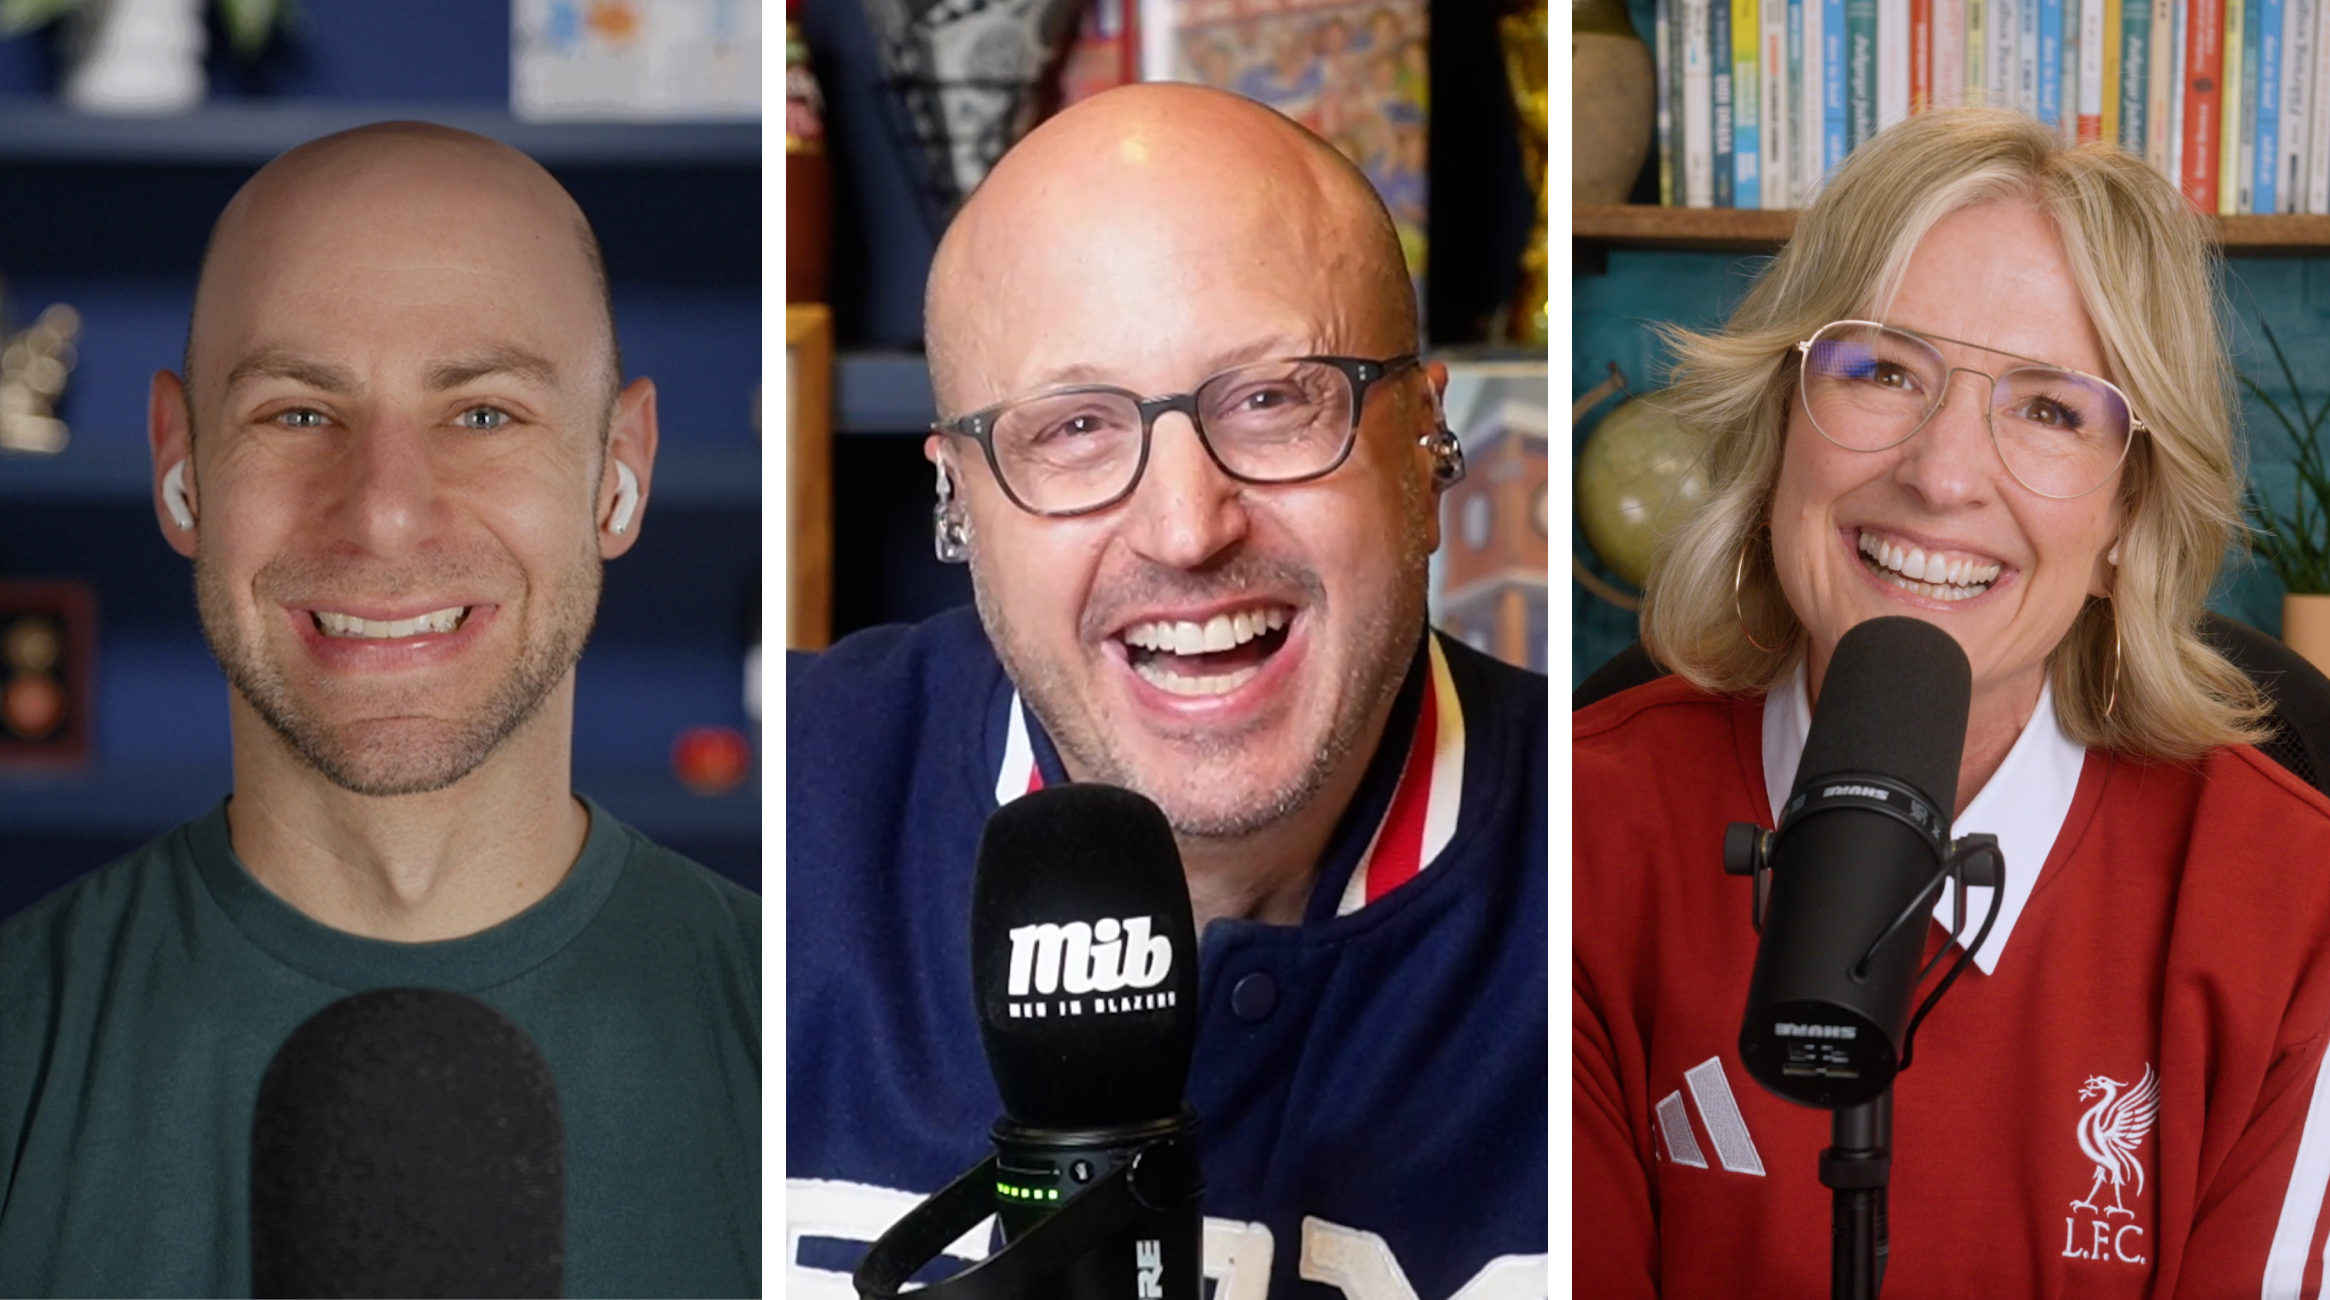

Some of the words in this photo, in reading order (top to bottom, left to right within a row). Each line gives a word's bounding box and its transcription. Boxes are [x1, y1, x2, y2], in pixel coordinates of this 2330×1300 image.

[1823, 785, 1889, 800] SHURE
[1009, 1002, 1047, 1018] MEN
[1059, 1000, 1082, 1016] IN
[1094, 991, 1176, 1014] BLAZERS
[1774, 1022, 1857, 1039] SHURE
